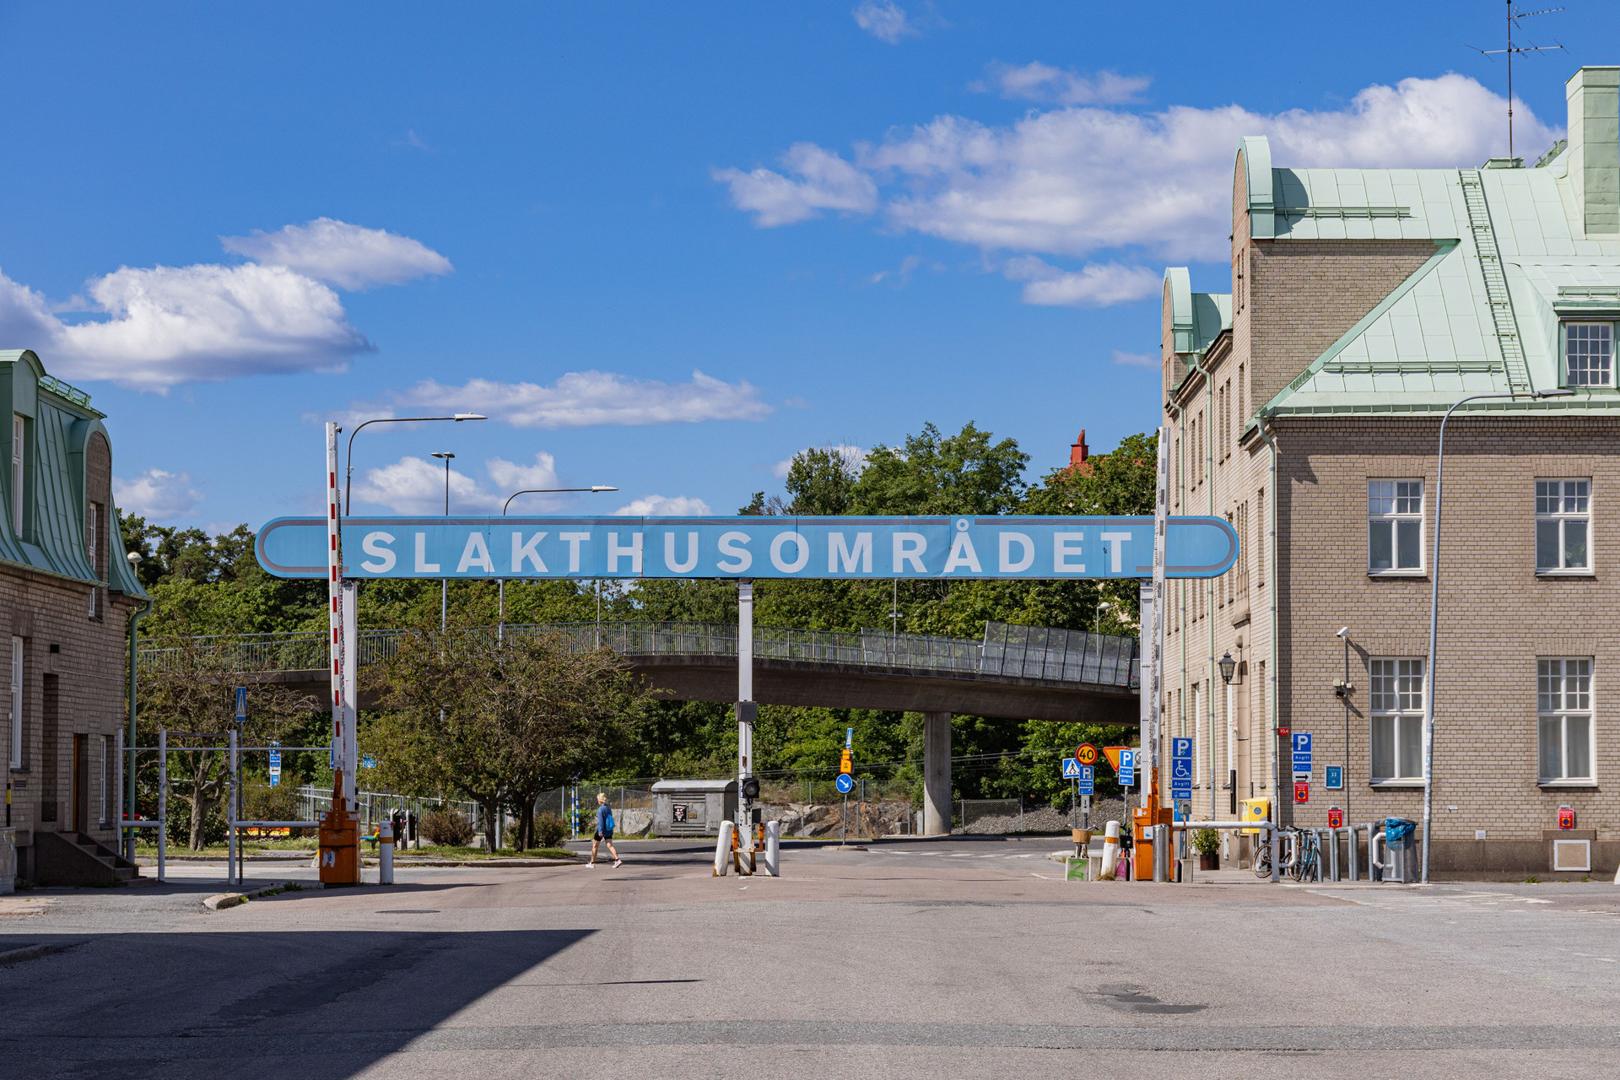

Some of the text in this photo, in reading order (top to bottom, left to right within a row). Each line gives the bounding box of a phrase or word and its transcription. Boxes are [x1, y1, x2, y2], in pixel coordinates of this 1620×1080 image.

[360, 518, 1132, 574] SLAKTHUSOMRÅDET
[1177, 740, 1189, 756] P
[1298, 736, 1308, 750] P
[1079, 750, 1094, 760] 40
[1123, 752, 1132, 766] P
